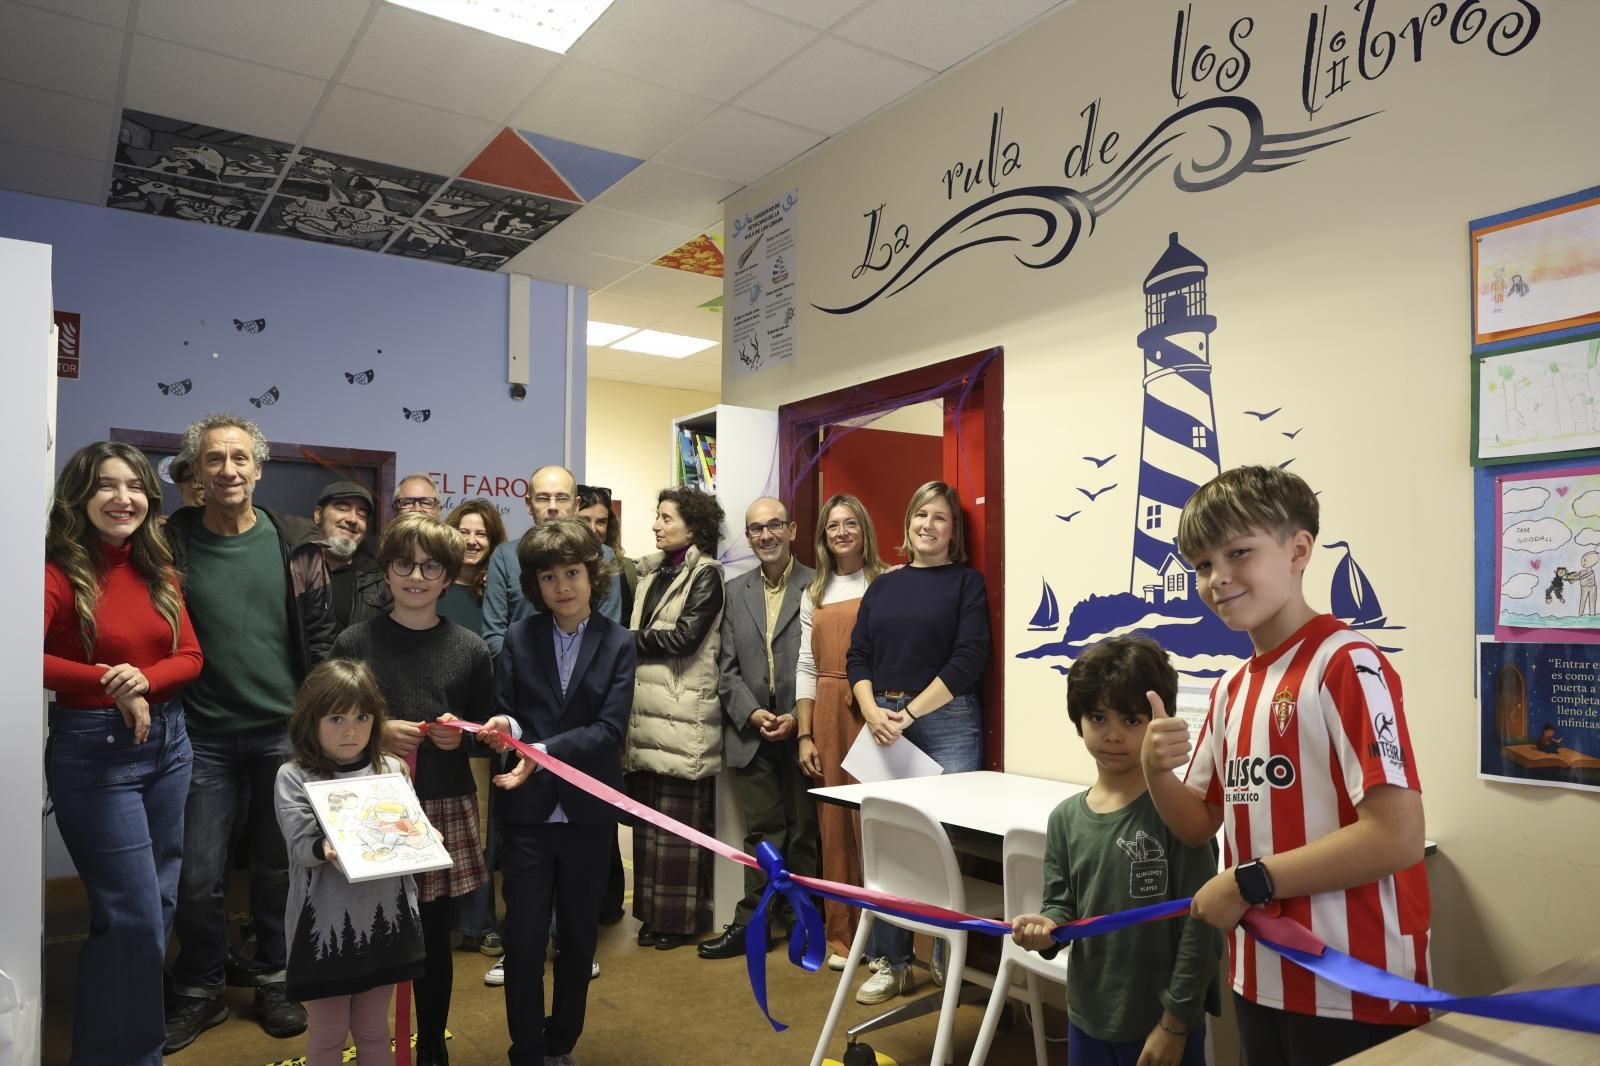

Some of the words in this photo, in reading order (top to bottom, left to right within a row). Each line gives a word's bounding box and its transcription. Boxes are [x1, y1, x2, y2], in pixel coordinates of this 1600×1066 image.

[851, 201, 910, 280] La
[942, 106, 1022, 200] rula
[1064, 97, 1120, 178] de
[1171, 2, 1254, 108] los
[57, 362, 77, 373] TOR
[463, 474, 529, 498] FARO
[1517, 535, 1552, 544] GOODALL
[1551, 672, 1563, 680] es
[1565, 673, 1595, 681] como
[1553, 684, 1588, 694] puerta
[1557, 705, 1583, 716] lleno
[1585, 707, 1598, 717] de
[1225, 756, 1295, 788] LISCO
